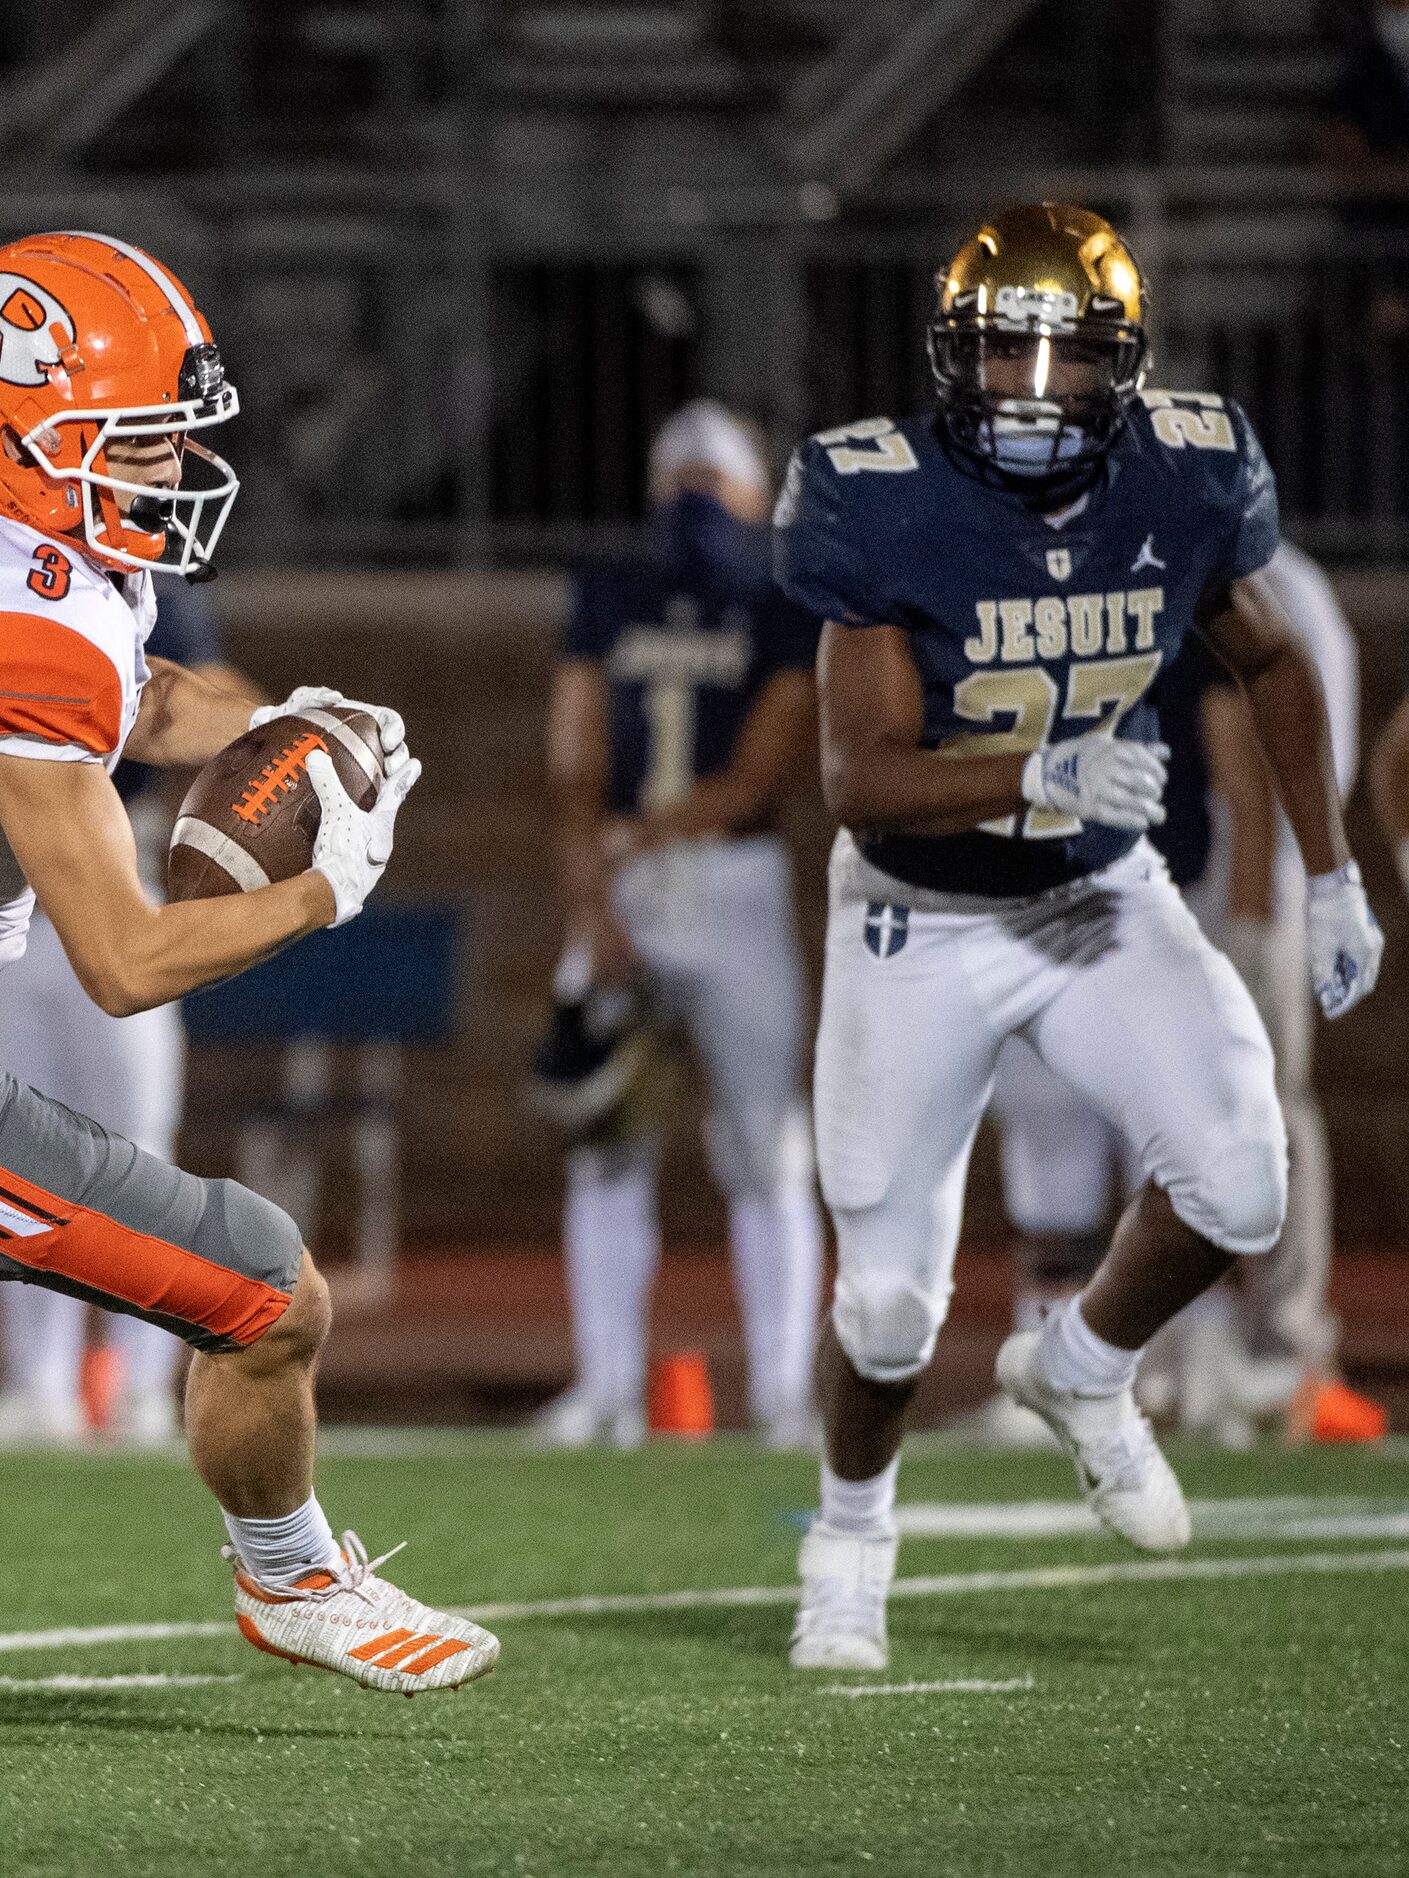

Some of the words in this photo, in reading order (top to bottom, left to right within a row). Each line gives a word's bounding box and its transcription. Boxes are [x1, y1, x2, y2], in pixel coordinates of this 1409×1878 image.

[26, 543, 72, 600] 3
[964, 587, 1164, 663] JESUIT
[939, 650, 1164, 840] 27
